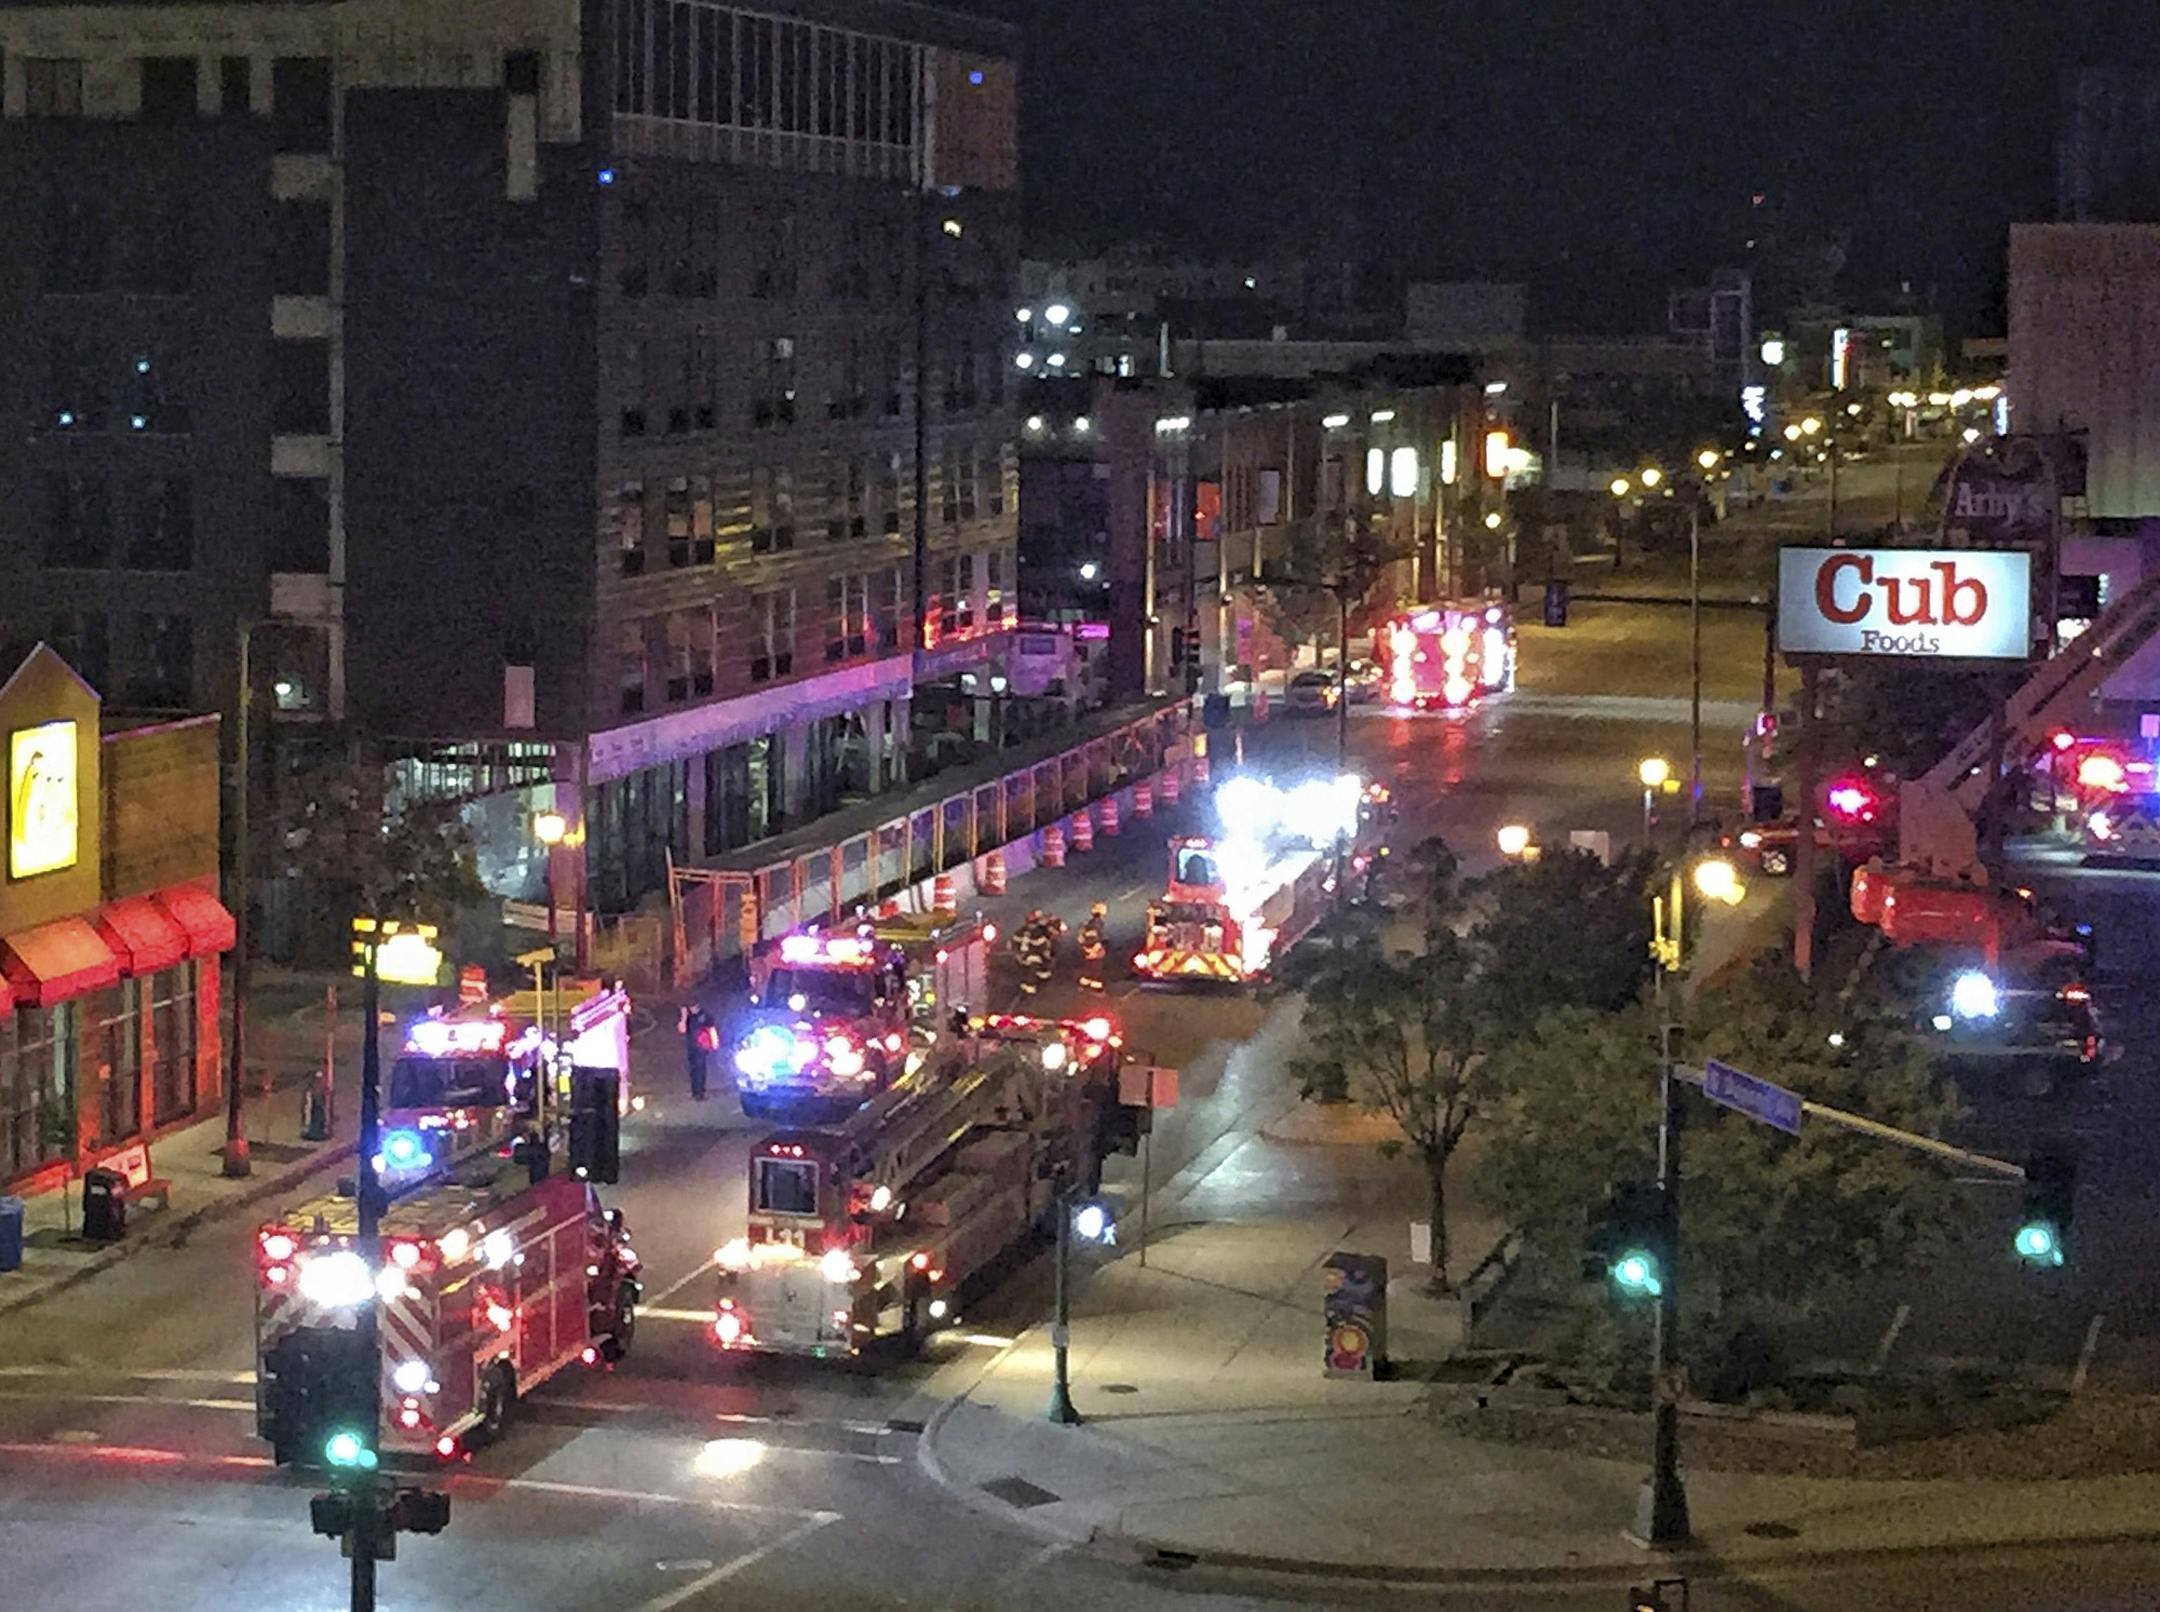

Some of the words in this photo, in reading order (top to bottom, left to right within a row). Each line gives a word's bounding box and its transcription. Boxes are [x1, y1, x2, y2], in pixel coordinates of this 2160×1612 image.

[1954, 482, 2044, 527] Arby's
[1815, 553, 1988, 626] Cub
[1860, 630, 1940, 653] Foods
